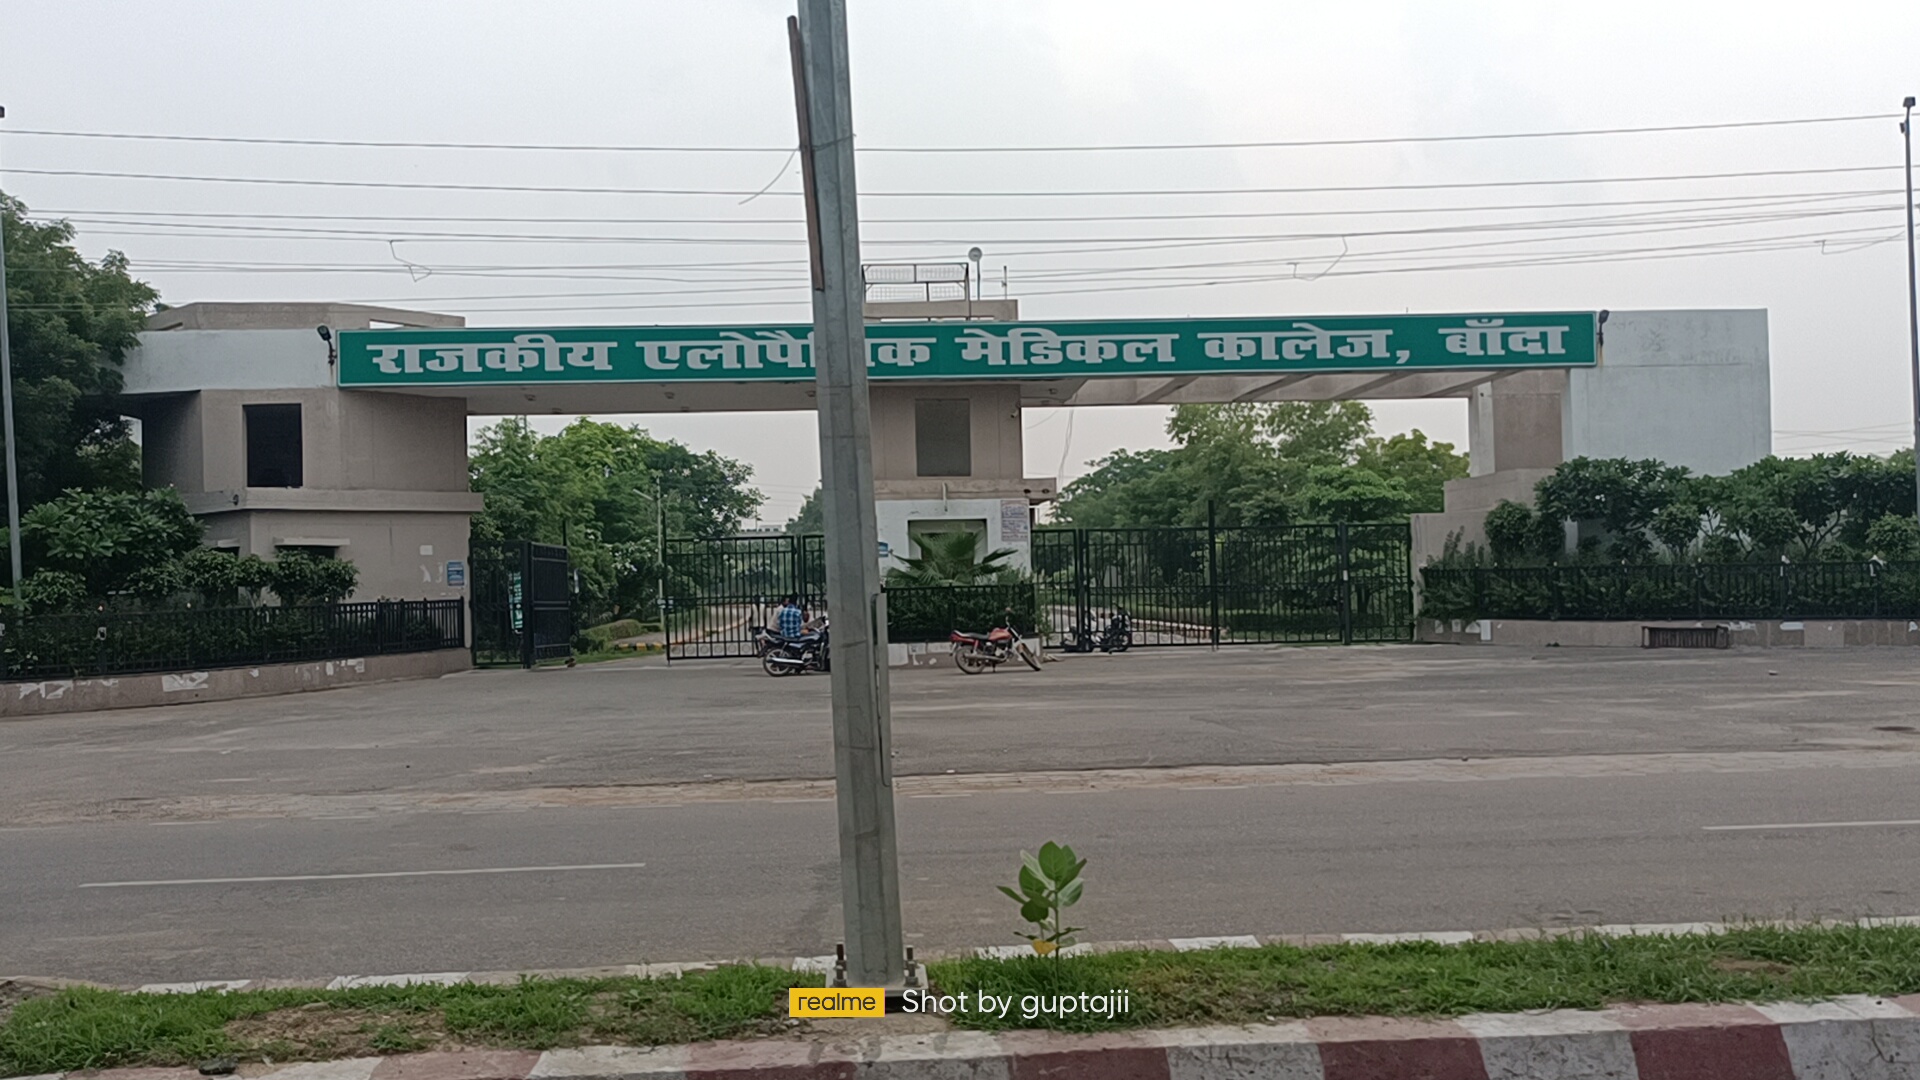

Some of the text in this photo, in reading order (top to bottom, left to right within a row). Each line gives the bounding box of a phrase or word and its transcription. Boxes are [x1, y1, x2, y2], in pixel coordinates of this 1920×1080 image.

[366, 333, 618, 374] राजकीय
[635, 329, 937, 370] एलोपैक
[955, 327, 1180, 365] मेडिकल
[1197, 322, 1410, 364] कालेज,
